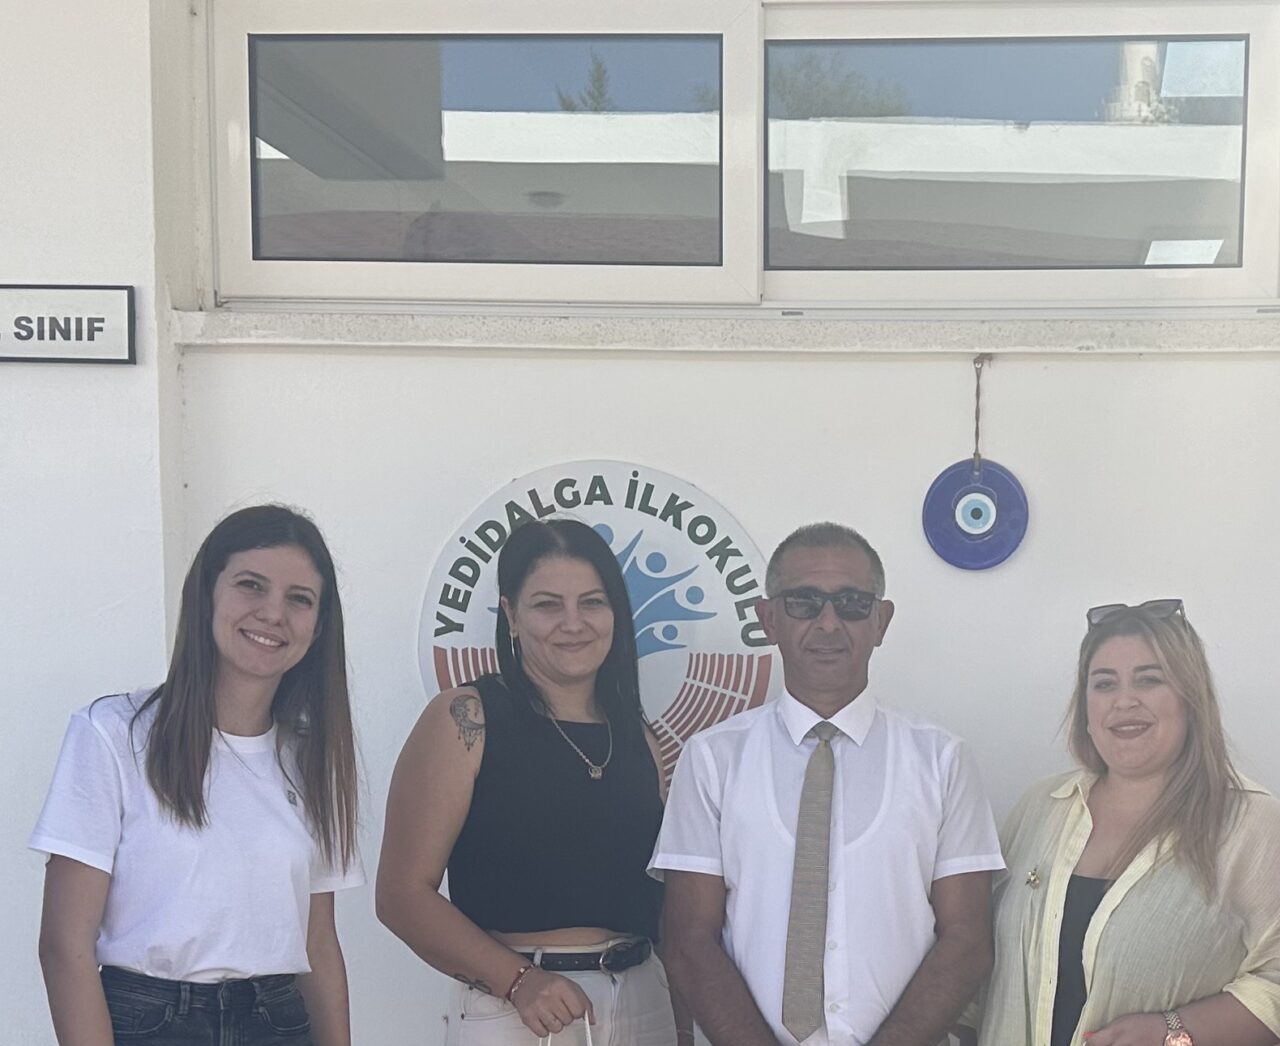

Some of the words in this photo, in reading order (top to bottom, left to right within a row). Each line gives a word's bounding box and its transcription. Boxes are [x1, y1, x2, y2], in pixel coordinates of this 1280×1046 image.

[13, 316, 105, 342] SINIF
[433, 475, 614, 637] YEDİDALGA
[624, 470, 769, 648] İLKOKULU
